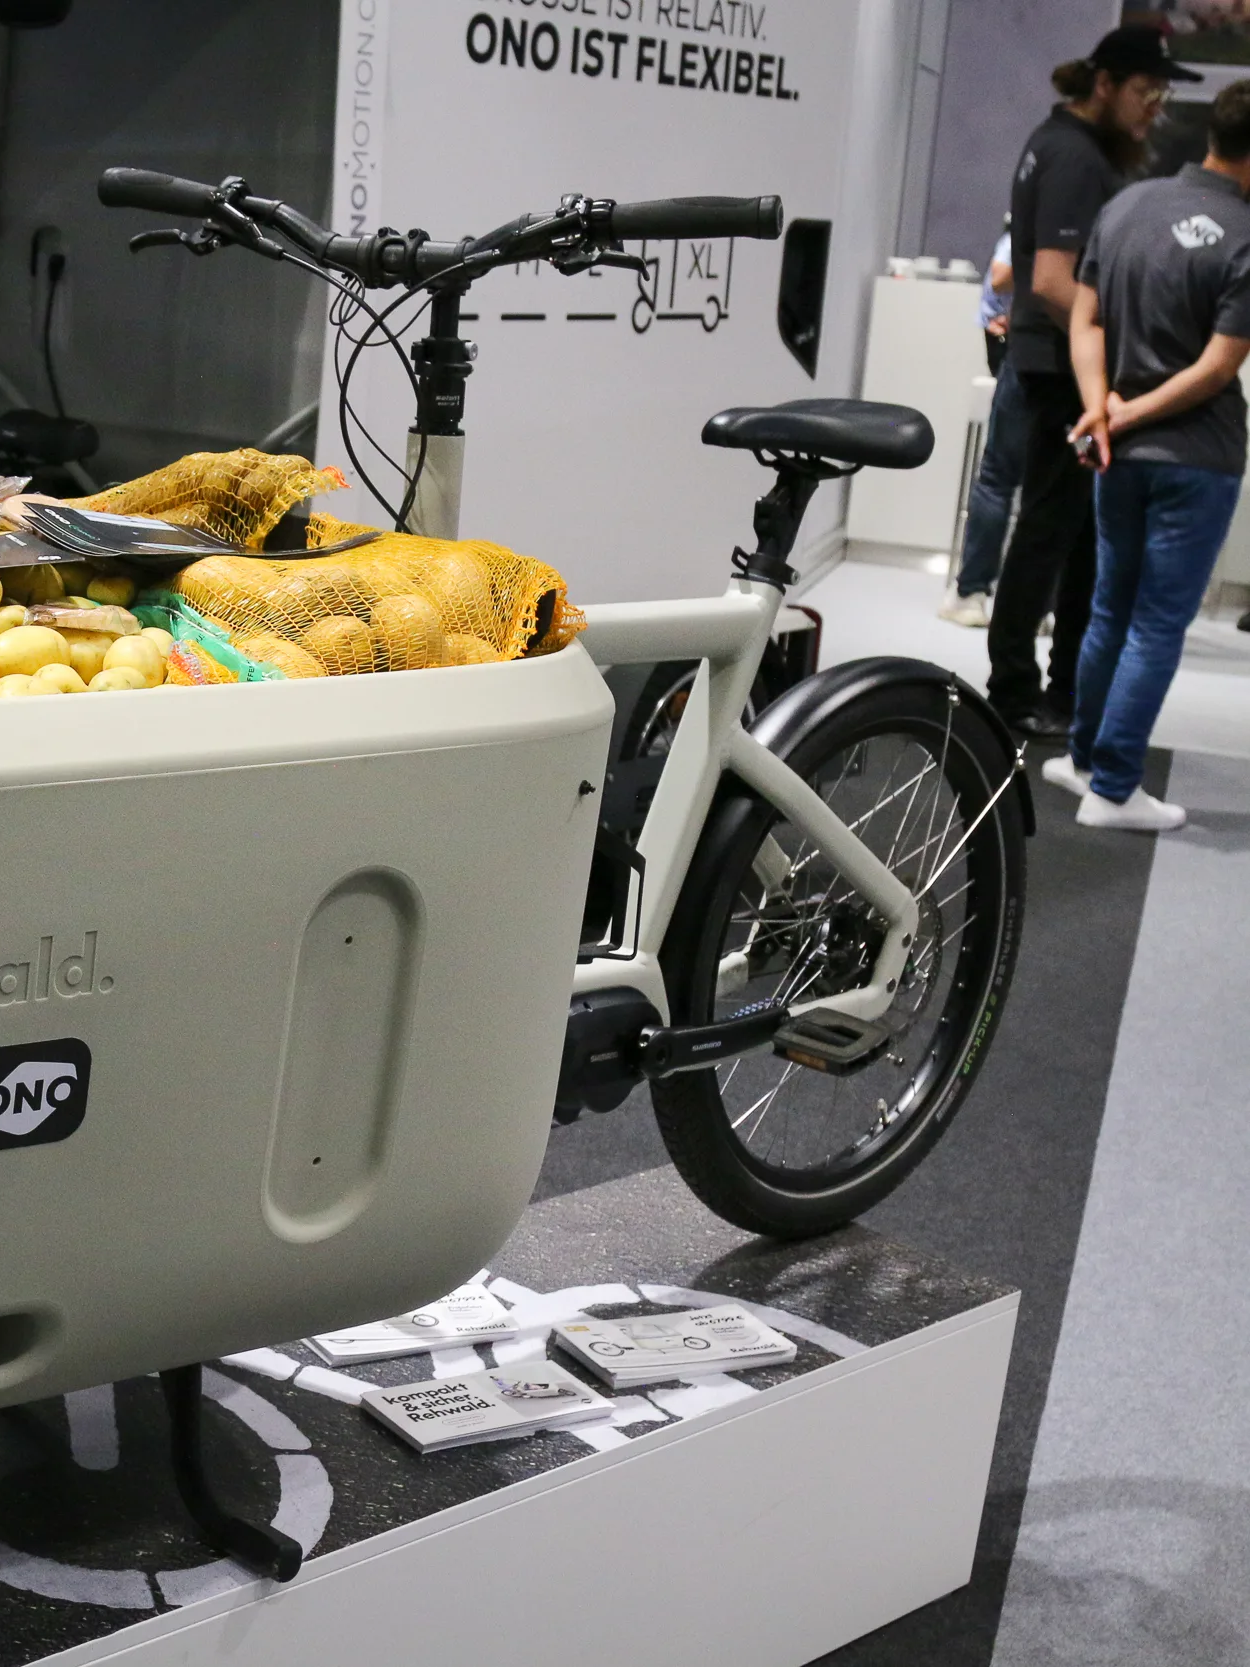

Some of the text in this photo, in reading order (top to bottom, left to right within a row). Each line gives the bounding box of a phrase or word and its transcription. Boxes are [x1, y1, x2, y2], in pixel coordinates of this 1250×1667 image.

[465, 12, 799, 101] ONO IST FLEXIBEL.
[688, 242, 719, 280] XL
[381, 1382, 469, 1406] kompakt
[402, 1392, 479, 1412] & sicher.
[407, 1398, 496, 1423] Rehwald.
